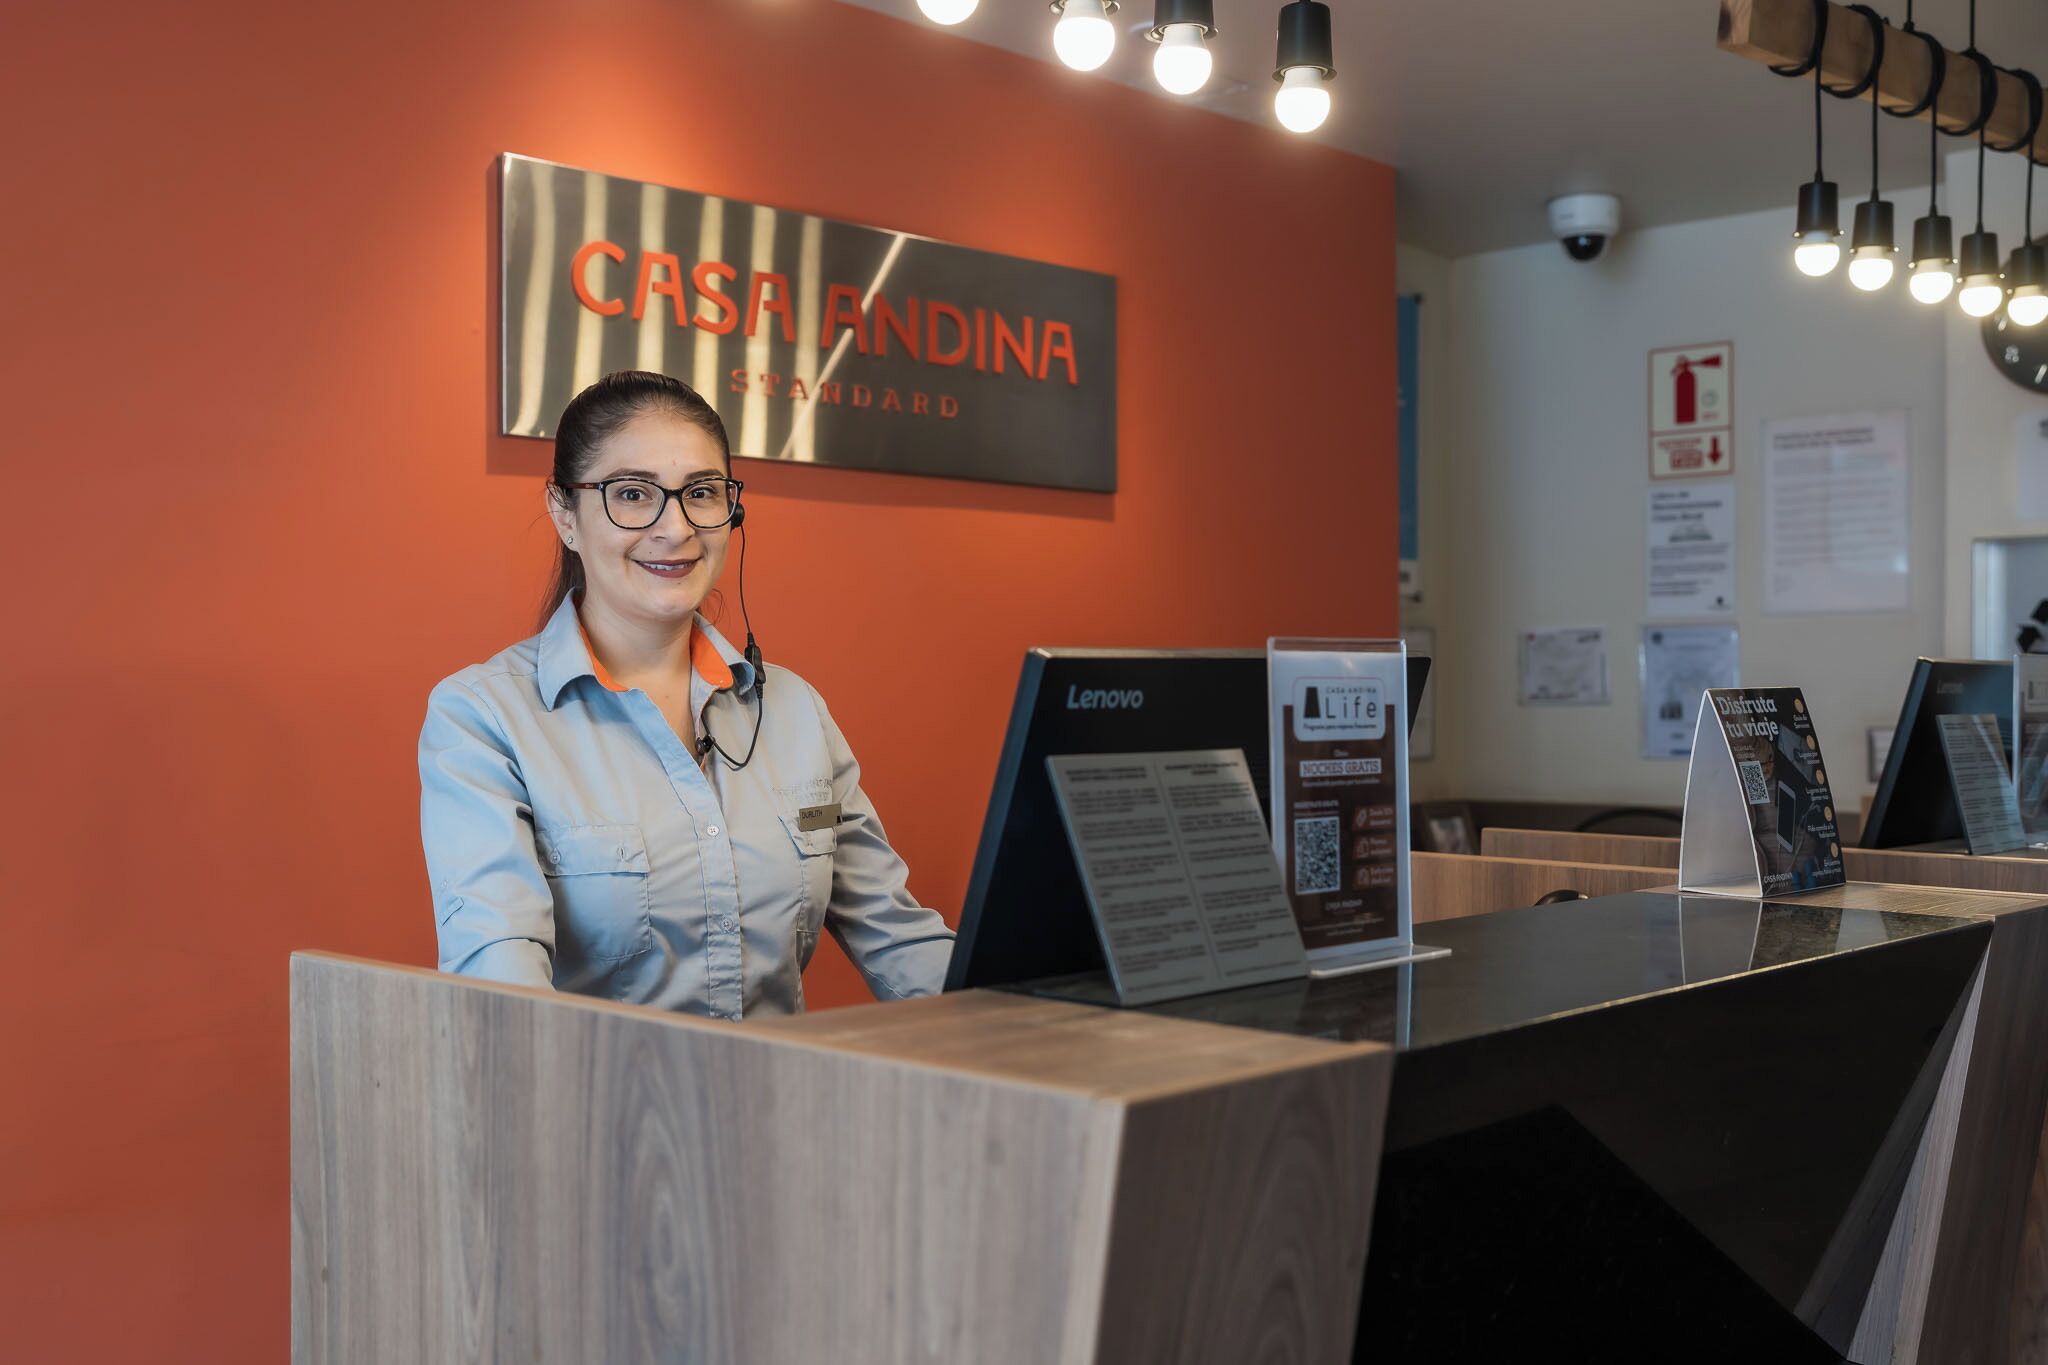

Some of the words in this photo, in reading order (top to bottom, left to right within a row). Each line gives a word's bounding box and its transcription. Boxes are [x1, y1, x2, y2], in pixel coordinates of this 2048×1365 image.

[571, 240, 796, 344] CASA
[821, 282, 1078, 386] ANDINA
[730, 368, 961, 419] STANDARD
[1066, 684, 1145, 711] Lenovo
[1325, 695, 1377, 719] Life
[1716, 696, 1777, 715] Disfruta
[1726, 721, 1744, 738] tu
[1745, 717, 1780, 741] viaje
[1302, 761, 1343, 776] NOCHES
[1345, 760, 1379, 774] GRATIS
